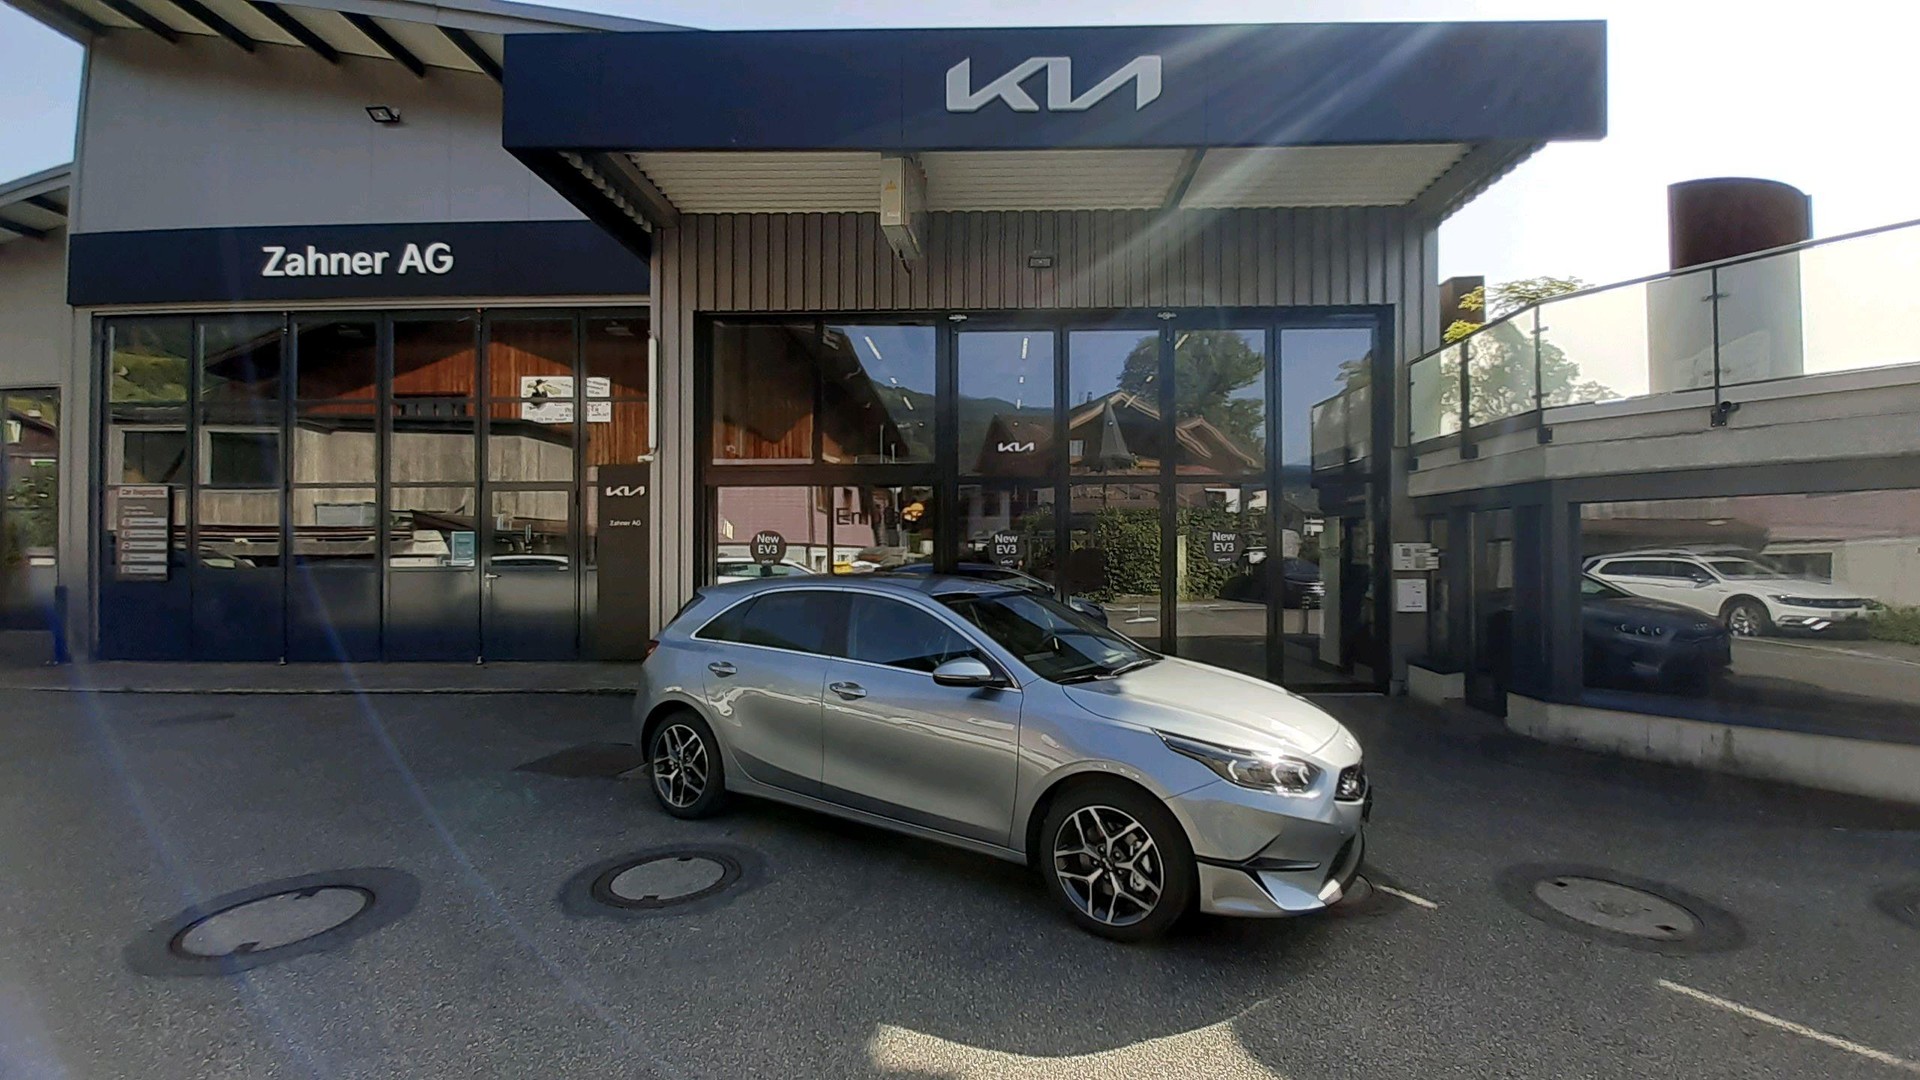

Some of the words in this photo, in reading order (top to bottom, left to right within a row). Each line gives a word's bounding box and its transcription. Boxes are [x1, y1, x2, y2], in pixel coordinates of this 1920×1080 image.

[946, 55, 1162, 112] KIA
[262, 245, 389, 277] Zahner
[398, 243, 454, 274] AG
[997, 441, 1035, 453] KIA
[605, 485, 645, 497] KIA
[757, 533, 780, 544] New
[995, 533, 1018, 544] New
[1212, 531, 1236, 541] New
[758, 544, 778, 554] EV3
[996, 544, 1017, 554] EV3
[1213, 542, 1234, 552] EV3
